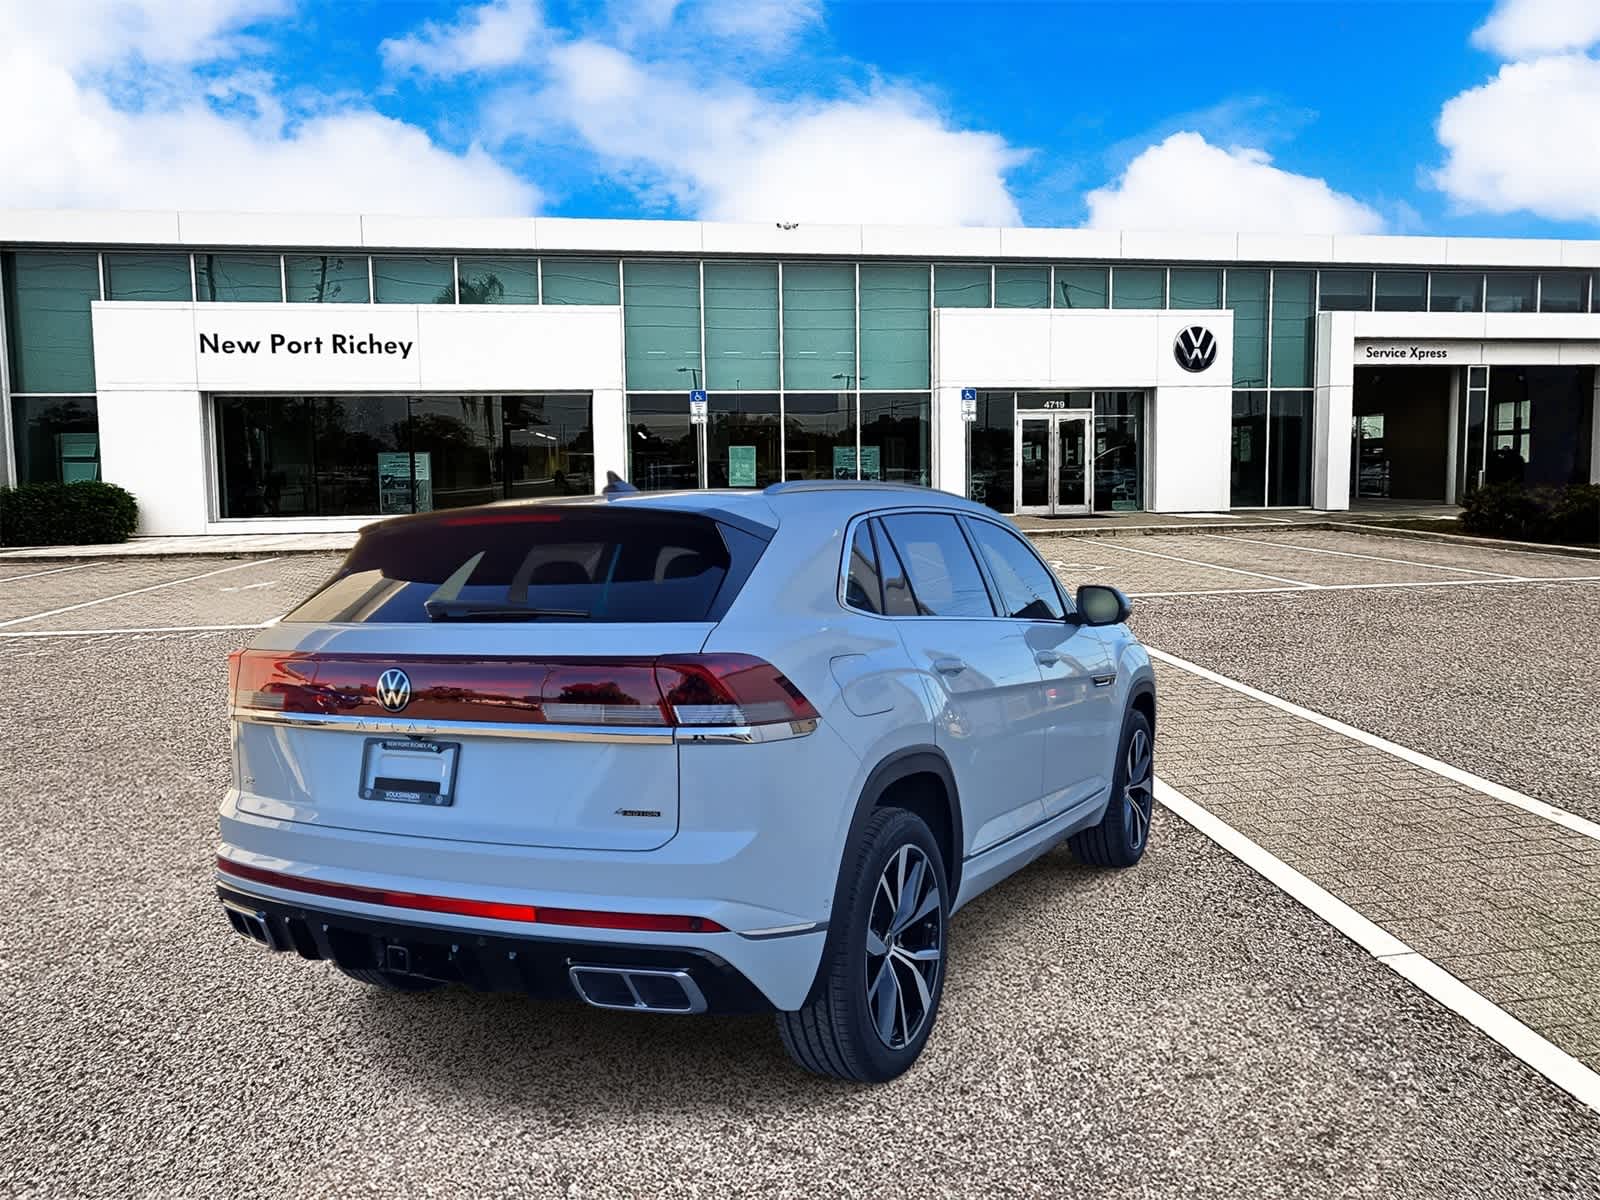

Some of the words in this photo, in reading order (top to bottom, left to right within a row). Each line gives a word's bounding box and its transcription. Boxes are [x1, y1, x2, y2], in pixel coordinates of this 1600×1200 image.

[199, 333, 261, 354] New
[270, 334, 323, 354] Port
[332, 333, 413, 359] Richey
[1366, 346, 1407, 358] Service
[1409, 347, 1447, 360] Xpress
[1044, 400, 1065, 409] 4719
